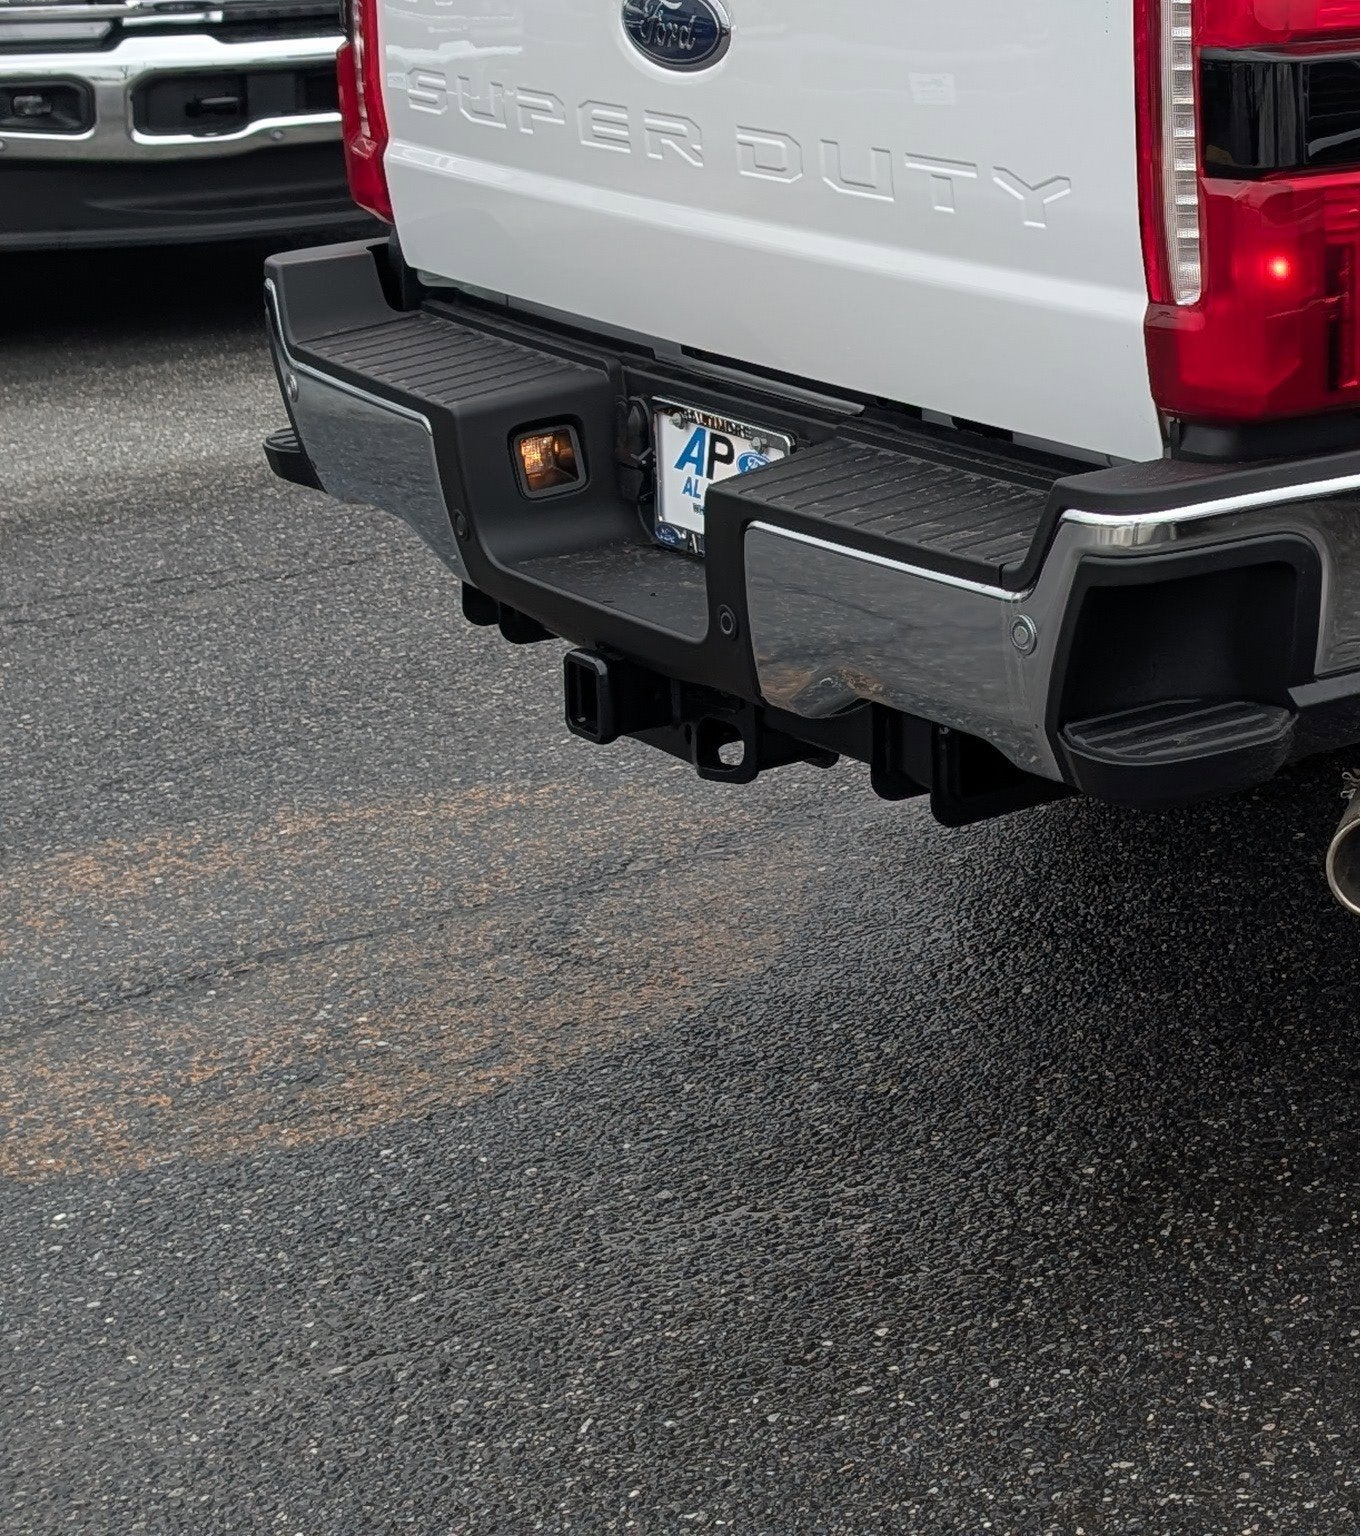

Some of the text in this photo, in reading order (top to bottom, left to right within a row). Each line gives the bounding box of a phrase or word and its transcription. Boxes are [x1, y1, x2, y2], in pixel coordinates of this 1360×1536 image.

[404, 66, 1073, 229] SUPER DUTY
[674, 426, 735, 480] AP
[682, 476, 702, 499] AL
